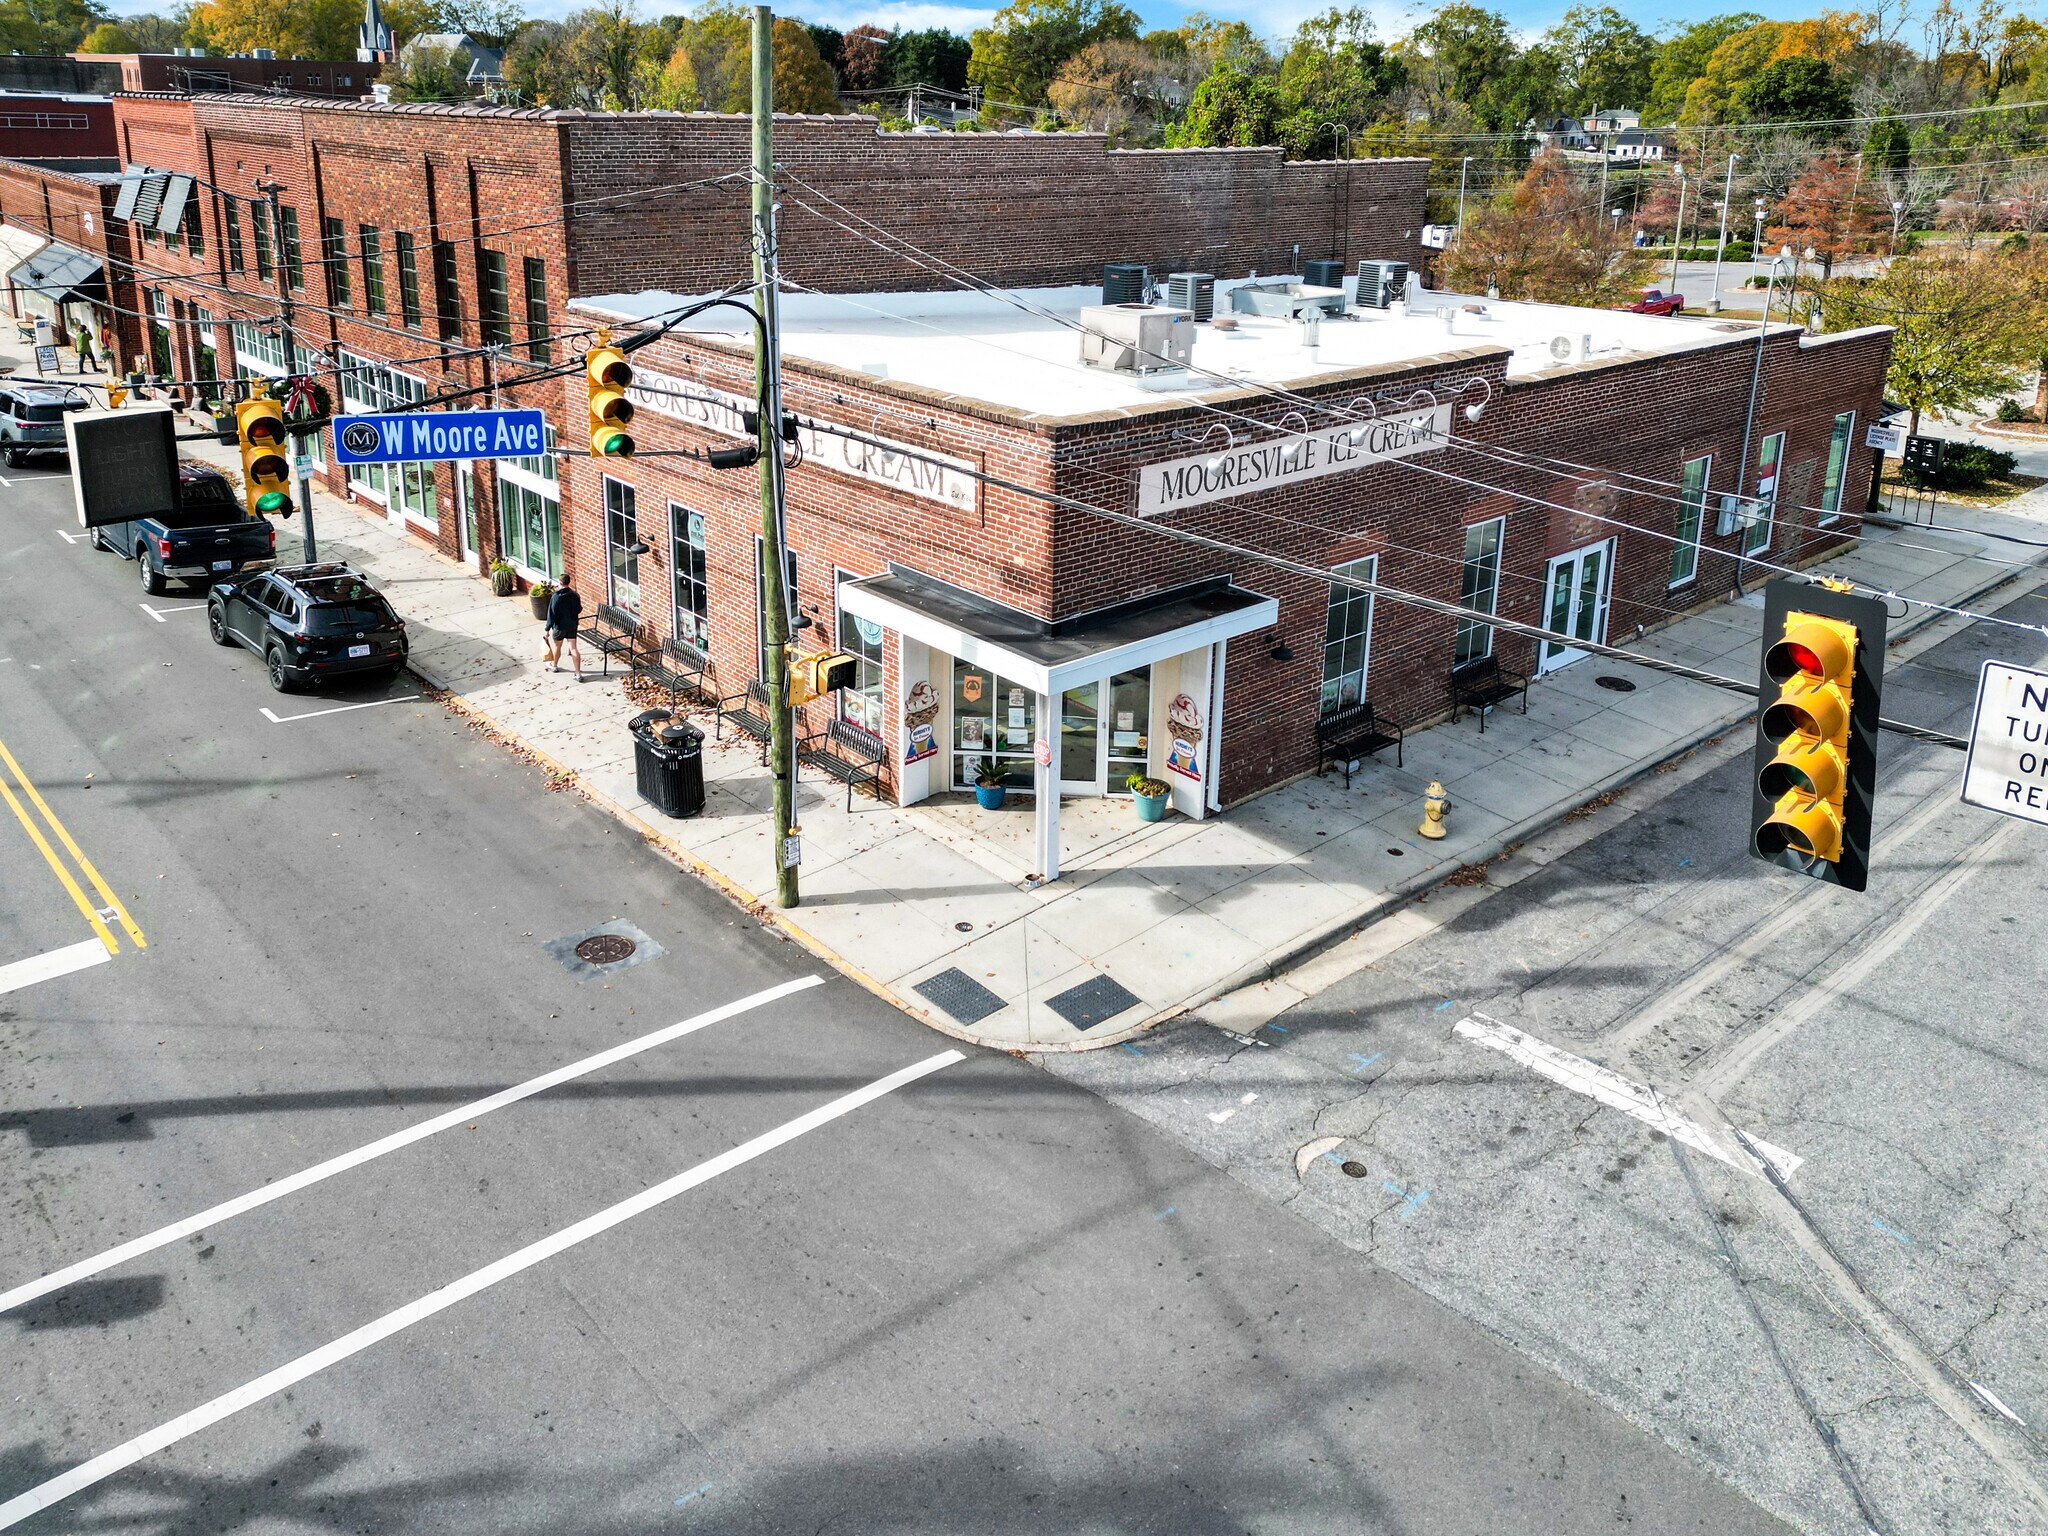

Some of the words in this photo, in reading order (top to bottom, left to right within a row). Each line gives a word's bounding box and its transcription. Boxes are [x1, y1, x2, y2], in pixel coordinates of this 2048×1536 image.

[626, 371, 760, 434] MOORESVIL
[381, 421, 404, 455] W
[411, 419, 487, 454] Moore
[494, 416, 539, 451] Ave
[1160, 438, 1317, 504] MOORESVILLE
[1328, 429, 1359, 465] ICE
[1370, 414, 1436, 454] CREAM
[2021, 683, 2048, 713] N
[2006, 715, 2048, 746] TU
[2004, 780, 2048, 811] RE
